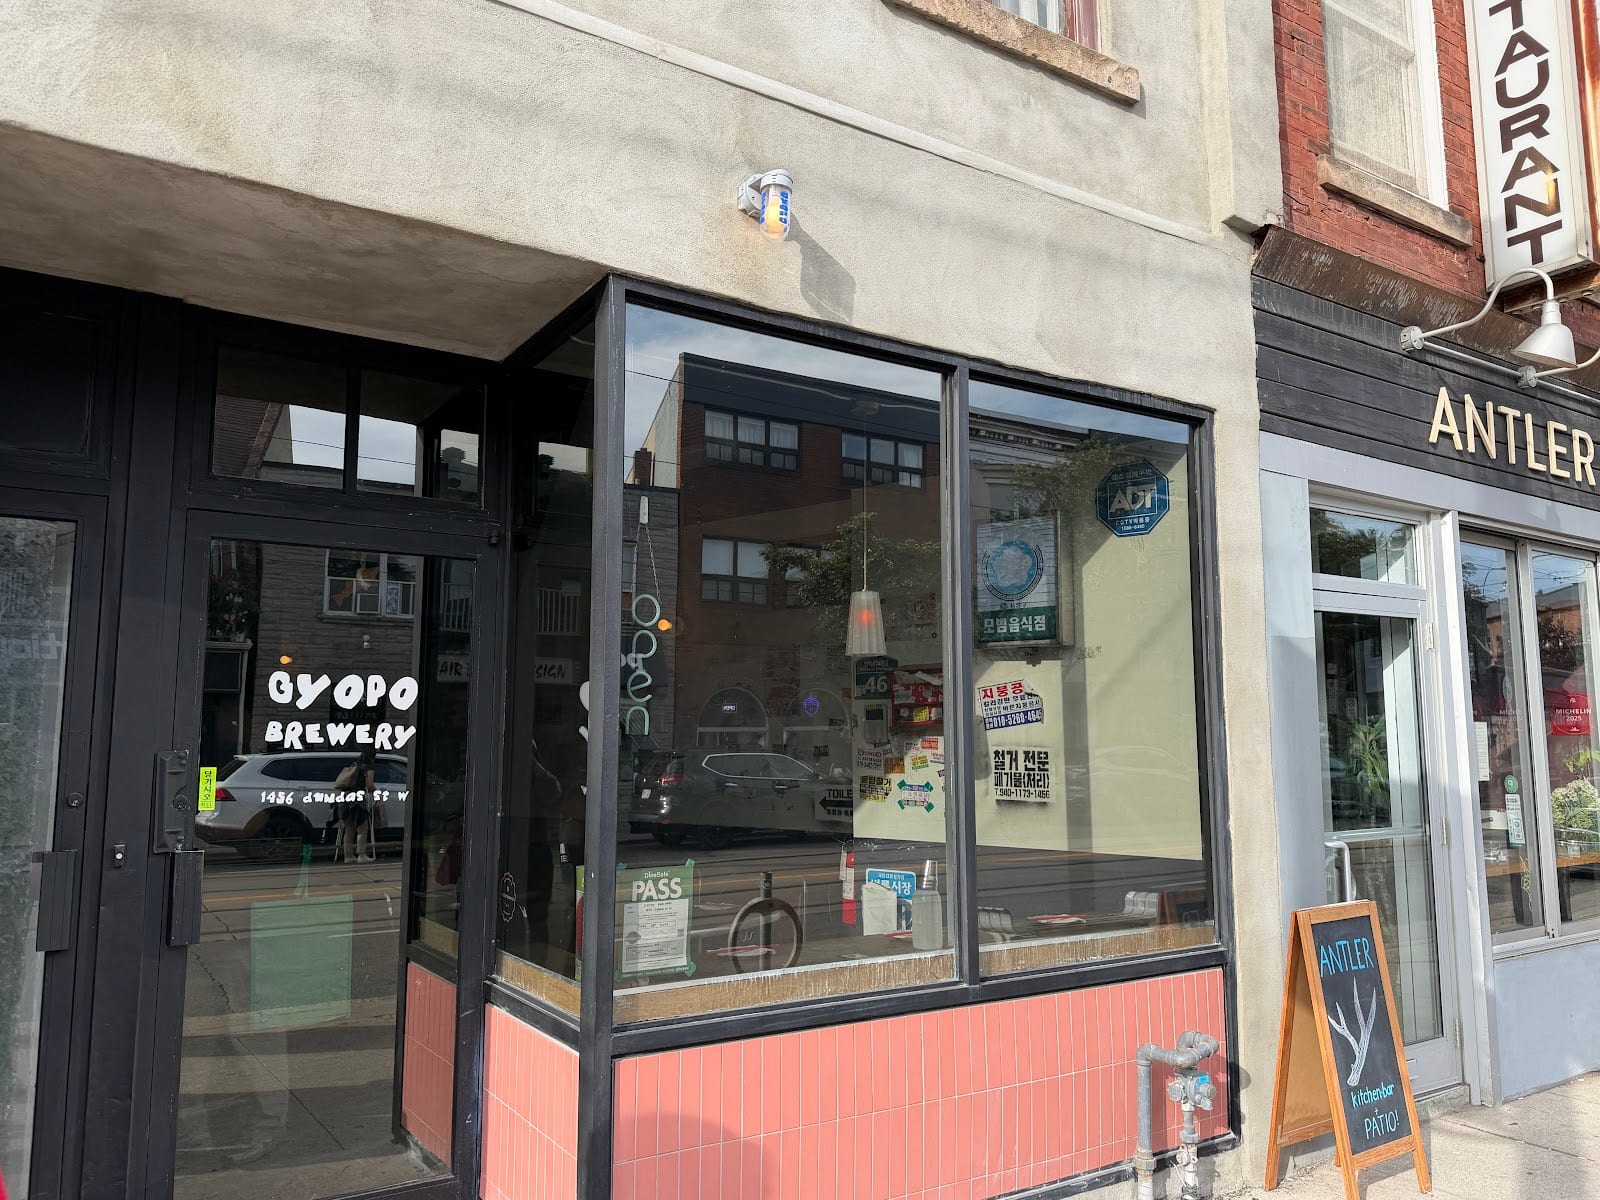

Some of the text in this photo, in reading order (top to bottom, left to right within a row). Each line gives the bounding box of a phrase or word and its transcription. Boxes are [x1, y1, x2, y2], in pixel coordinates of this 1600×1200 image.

[1489, 0, 1563, 266] TAURANT
[1429, 386, 1596, 486] ANTLER
[1109, 483, 1156, 513] ADT
[983, 614, 1046, 634] 모범음식점
[625, 594, 661, 736] open
[268, 671, 419, 711] GYOPO
[265, 721, 416, 750] BREWERY
[260, 790, 294, 805] 1456
[826, 788, 854, 799] TOILE
[631, 877, 683, 901] PASS
[1320, 937, 1374, 978] ANTLER
[1364, 1110, 1400, 1139] PATIO!
